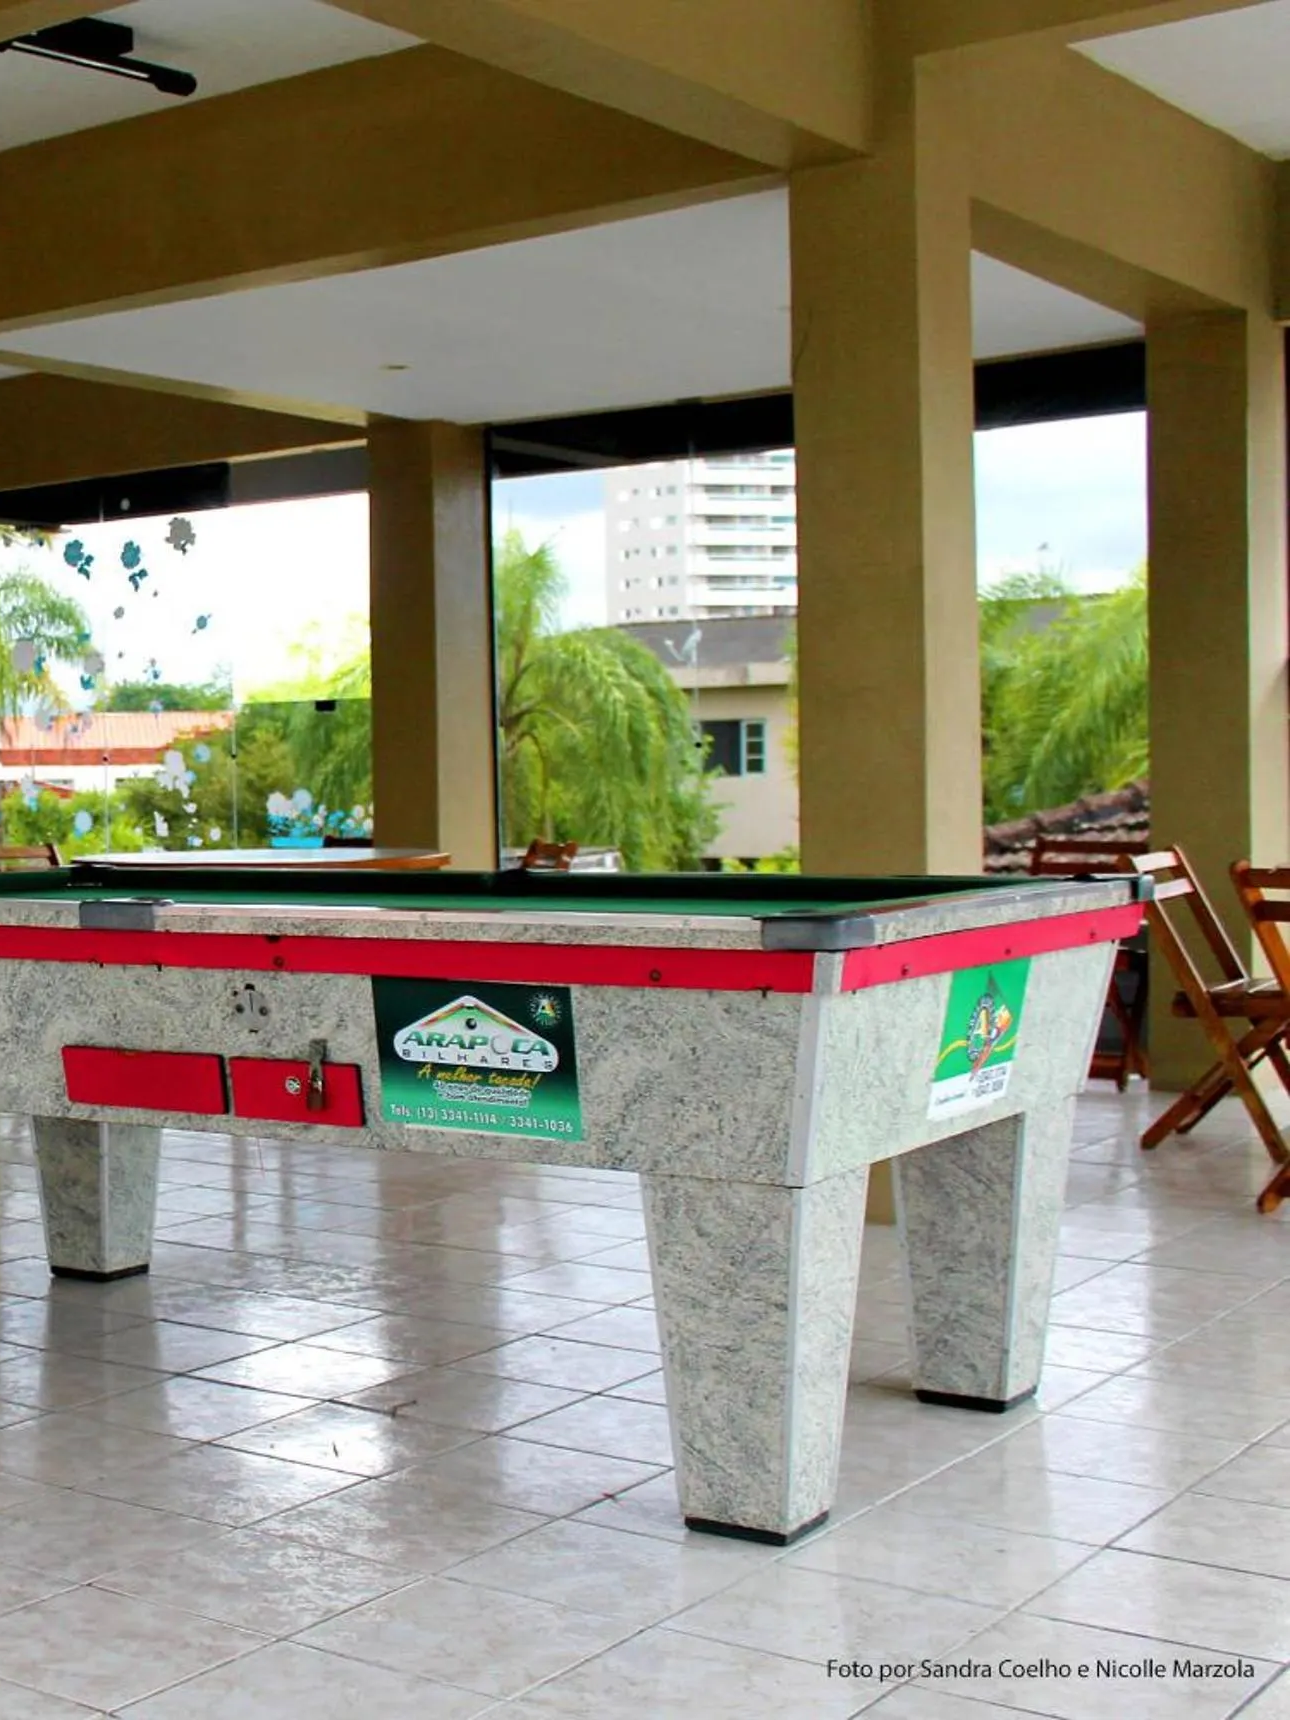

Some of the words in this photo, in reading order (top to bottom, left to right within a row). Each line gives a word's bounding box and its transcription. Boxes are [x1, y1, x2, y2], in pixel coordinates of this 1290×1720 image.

[402, 1050, 554, 1070] BILHARES
[417, 1063, 434, 1080] A
[416, 1106, 438, 1120] (13)
